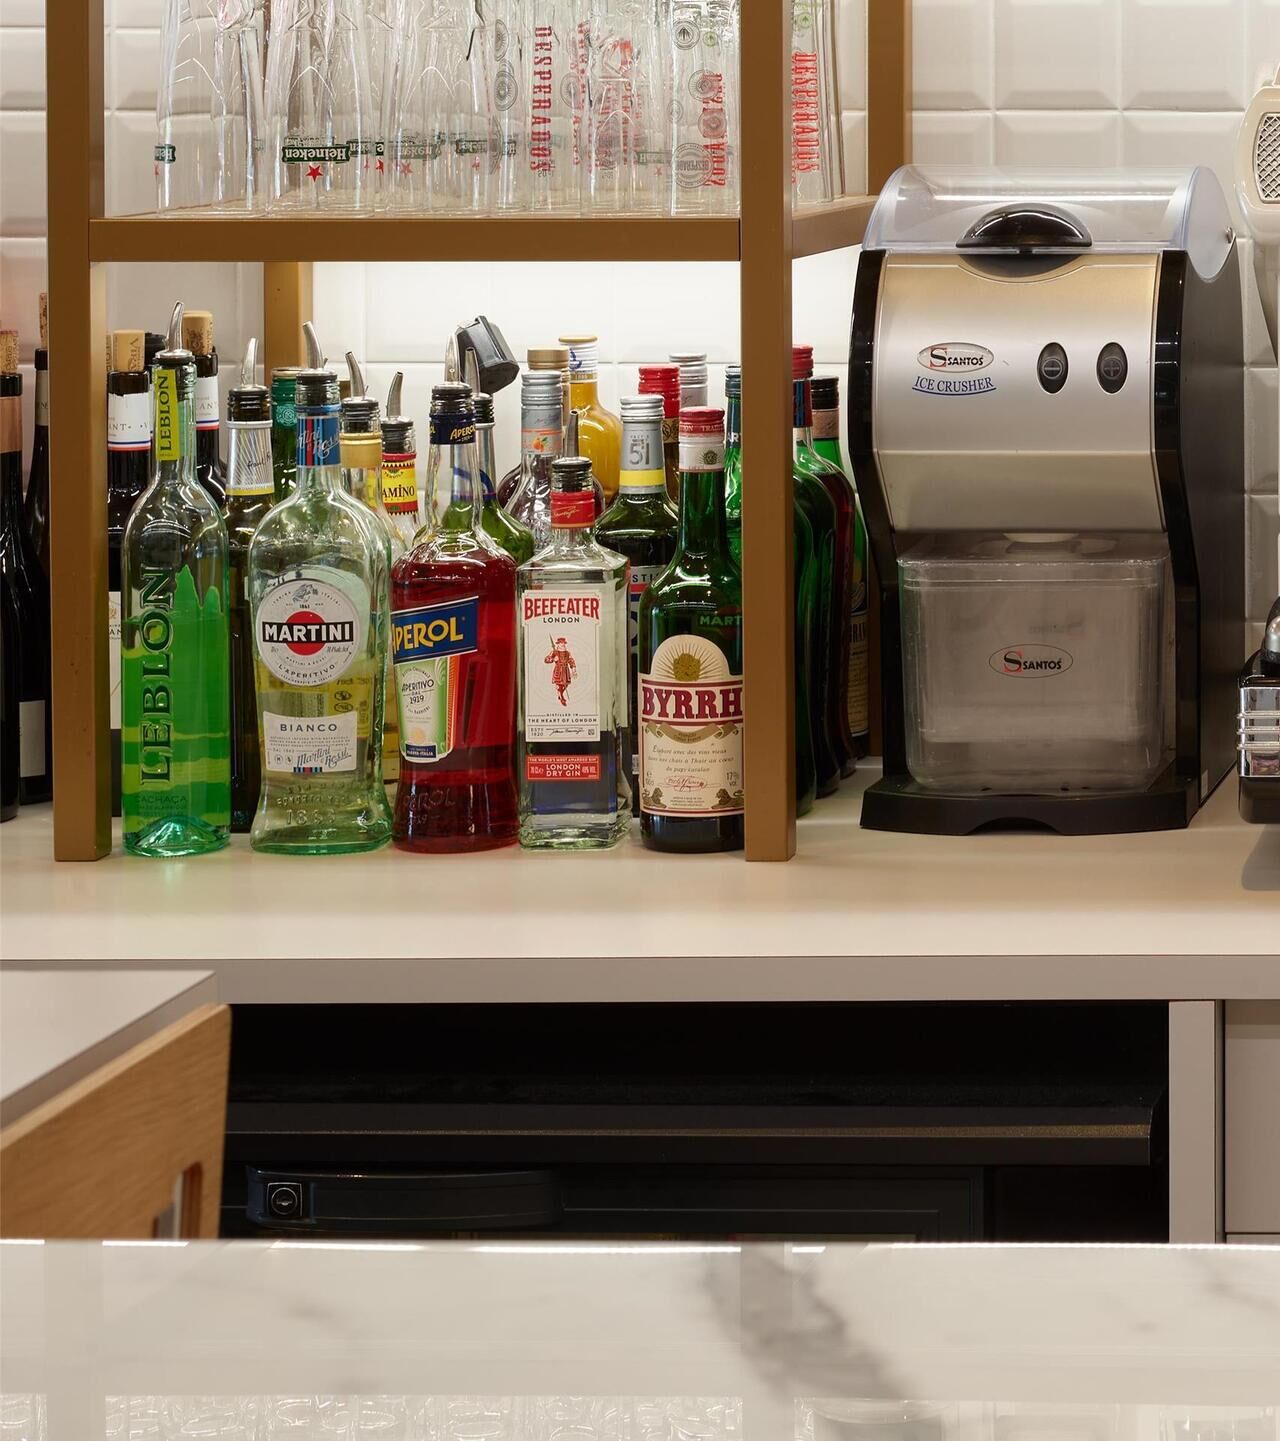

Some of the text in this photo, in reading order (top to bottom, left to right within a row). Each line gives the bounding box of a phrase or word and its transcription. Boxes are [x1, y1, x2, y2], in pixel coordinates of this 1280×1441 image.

[530, 25, 554, 173] DESPERADOS
[283, 146, 350, 163] Heineken
[948, 355, 984, 366] SANTOS
[913, 375, 995, 393] ICE CRUSHER
[158, 375, 173, 452] LEBLON
[523, 597, 600, 621] BEEFEATER
[542, 616, 581, 624] LONDON
[264, 623, 351, 642] MARTINI
[277, 664, 336, 679] L'APERITIVO
[1022, 660, 1062, 671] SANTOS
[141, 564, 176, 787] LEBLON
[401, 679, 435, 693] APERITIVO
[642, 687, 744, 719] BYRRH
[279, 723, 338, 733] BIANCO
[545, 763, 581, 771] LONDON
[545, 770, 581, 778] DRY GIN
